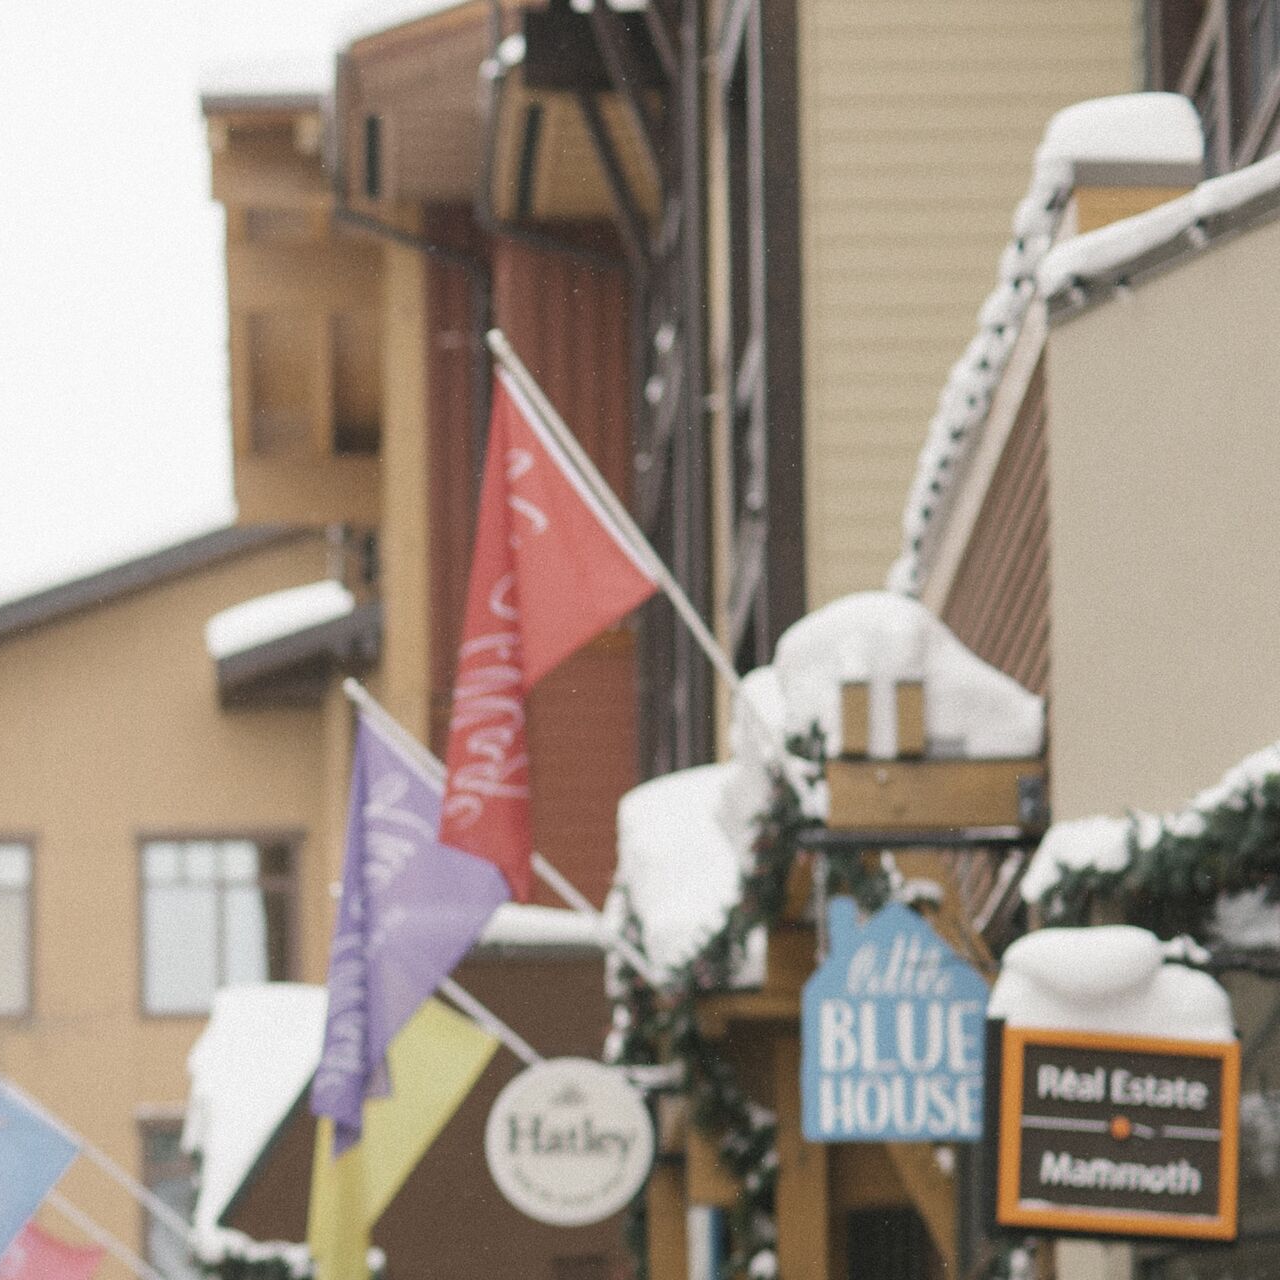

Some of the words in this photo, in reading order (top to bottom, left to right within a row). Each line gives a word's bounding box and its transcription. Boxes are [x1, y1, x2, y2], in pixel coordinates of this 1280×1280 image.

[820, 999, 982, 1073] BLUE
[819, 1073, 983, 1136] HOUSE
[1037, 1063, 1107, 1103] Real
[1110, 1068, 1210, 1111] Estate
[507, 1112, 636, 1165] Hatley
[1040, 1150, 1203, 1196] Mammoth
